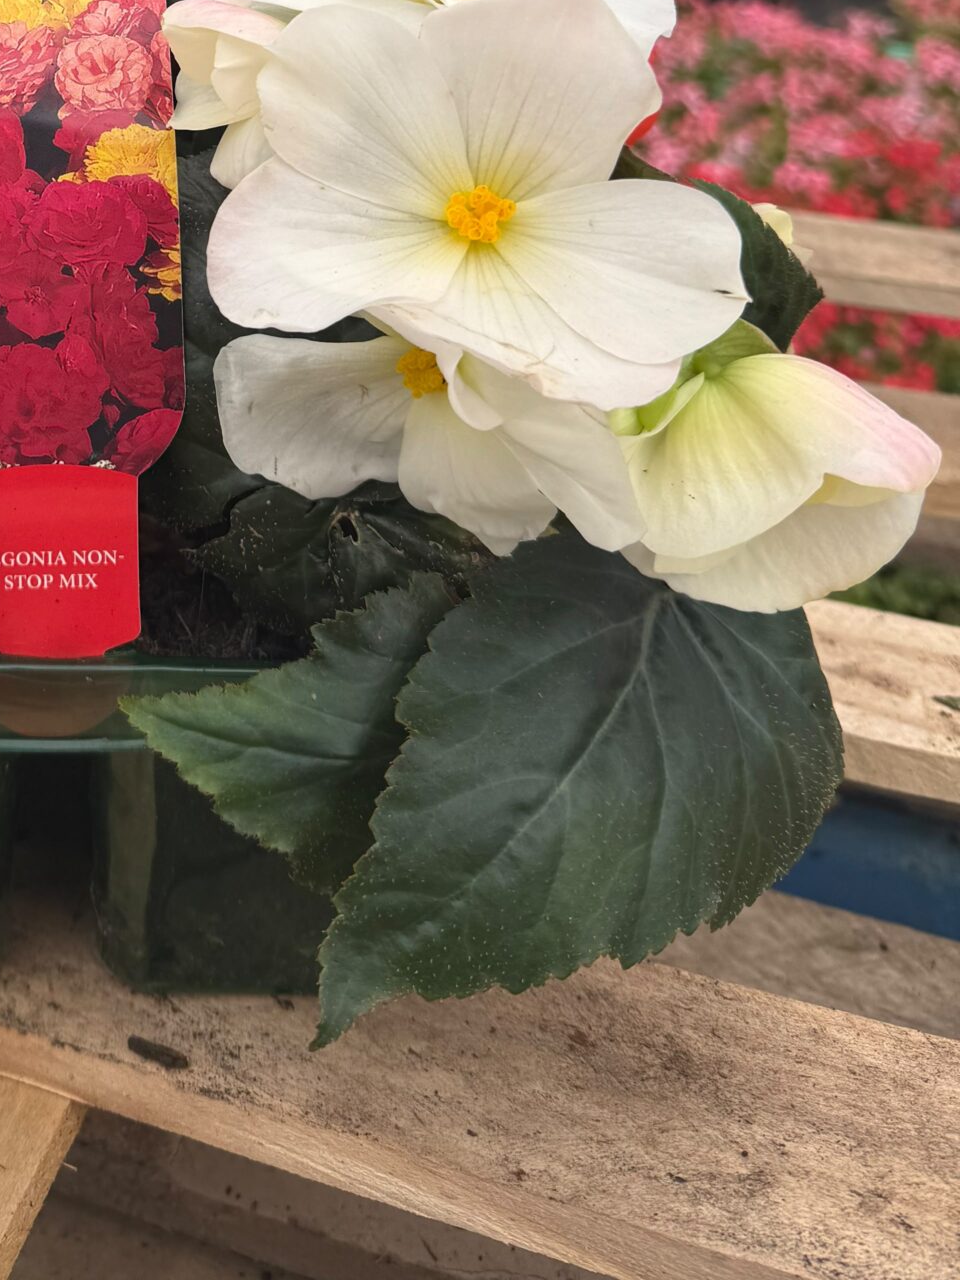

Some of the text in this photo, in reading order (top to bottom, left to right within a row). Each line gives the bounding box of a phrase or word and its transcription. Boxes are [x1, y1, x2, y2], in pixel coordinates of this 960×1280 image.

[72, 549, 125, 567] NON-
[3, 572, 98, 591] STOP MIX
